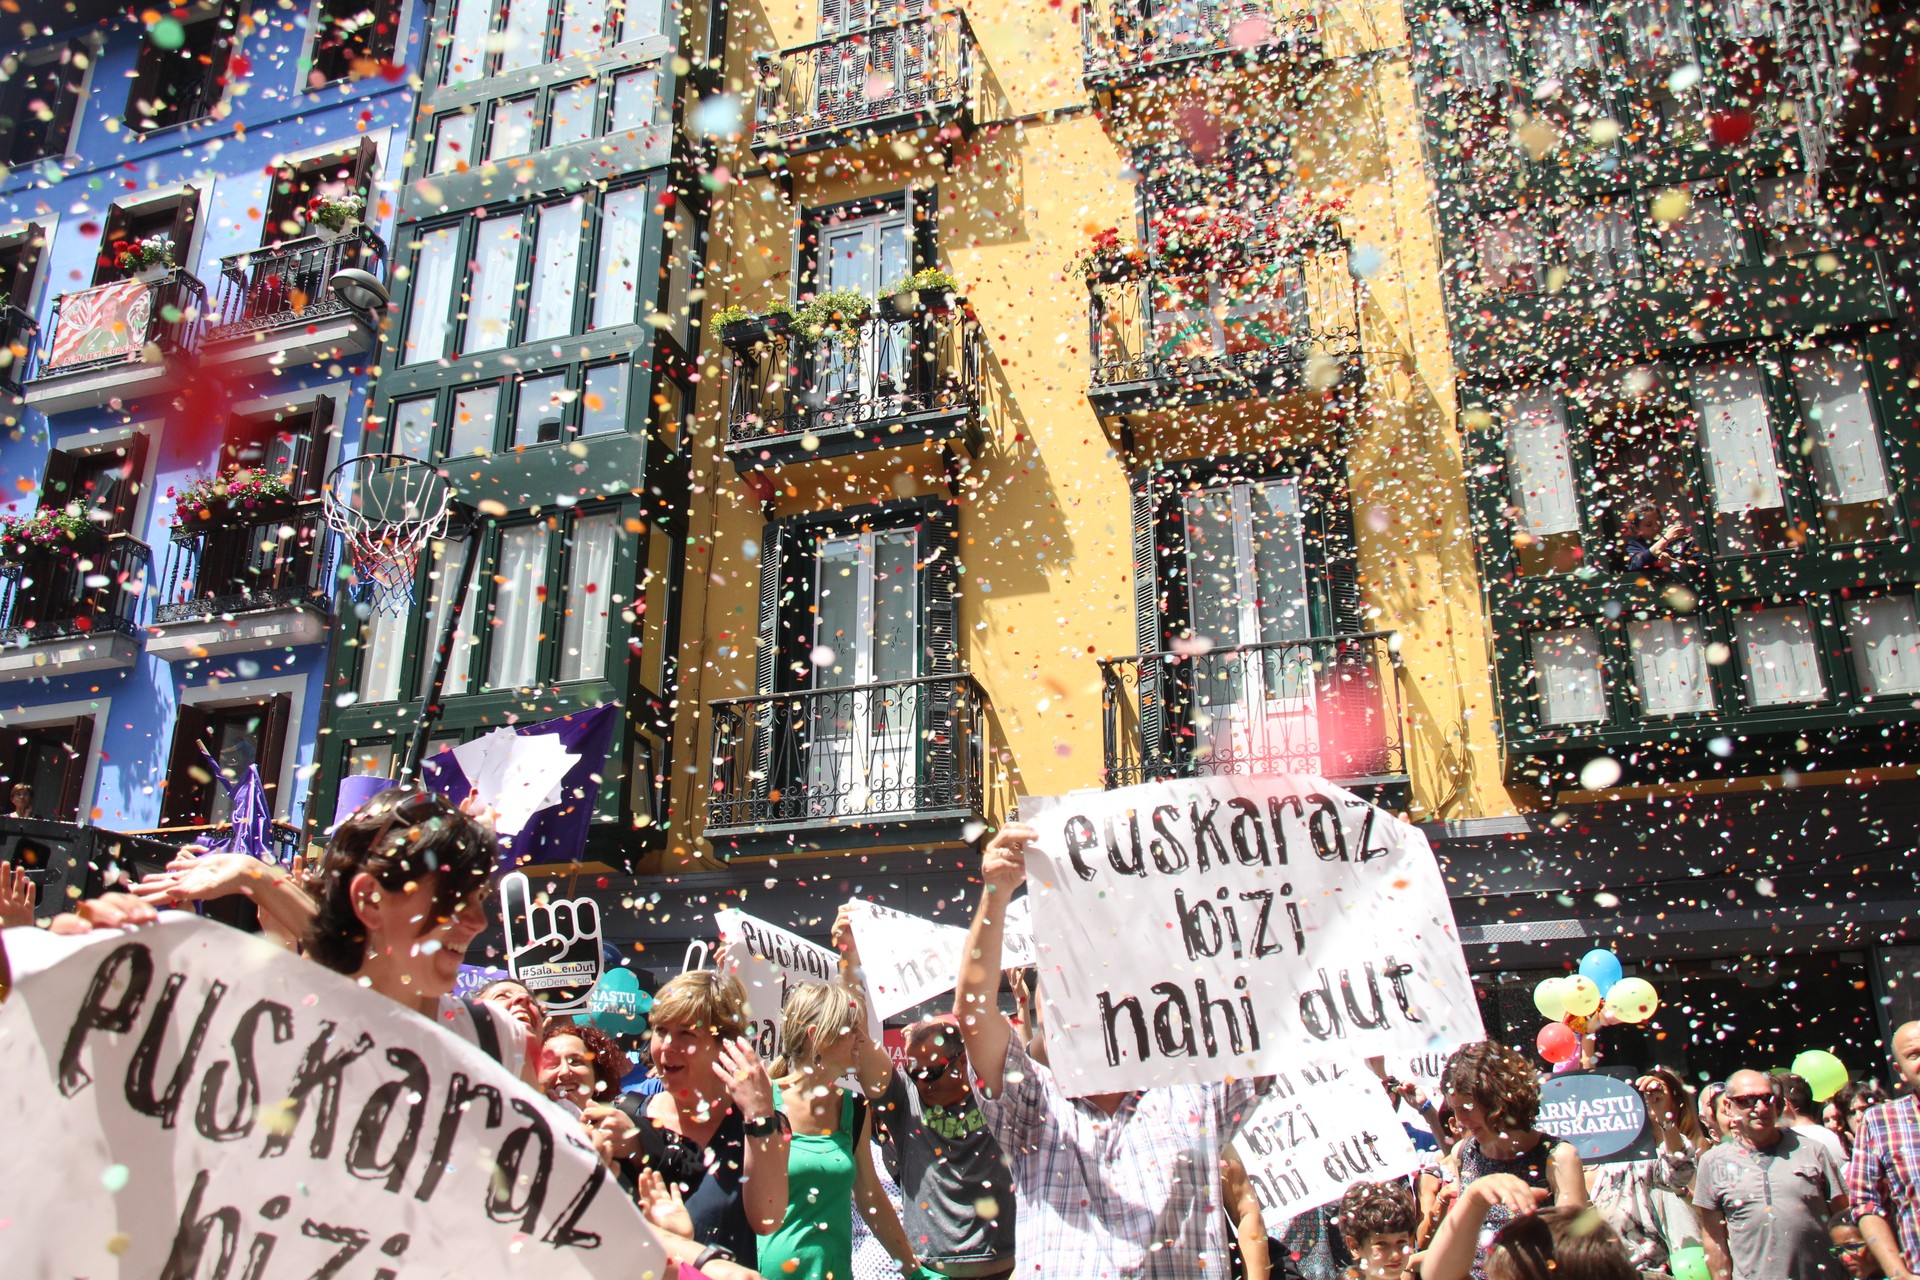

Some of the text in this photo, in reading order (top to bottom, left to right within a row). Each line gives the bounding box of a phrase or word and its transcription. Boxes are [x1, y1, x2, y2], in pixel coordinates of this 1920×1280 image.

[1063, 793, 1390, 882] euskaraz
[741, 920, 840, 980] euskar
[1174, 883, 1307, 961] bizi
[522, 962, 594, 977] #SalaenDut
[528, 976, 591, 989] #YoDencio
[590, 989, 636, 1005] NASTU
[591, 1001, 636, 1015] KARA!!
[1097, 956, 1421, 1067] nahi dut
[58, 942, 604, 1250] euskaraz
[1240, 1103, 1319, 1160] bizi
[1249, 1130, 1389, 1212] ahi dut
